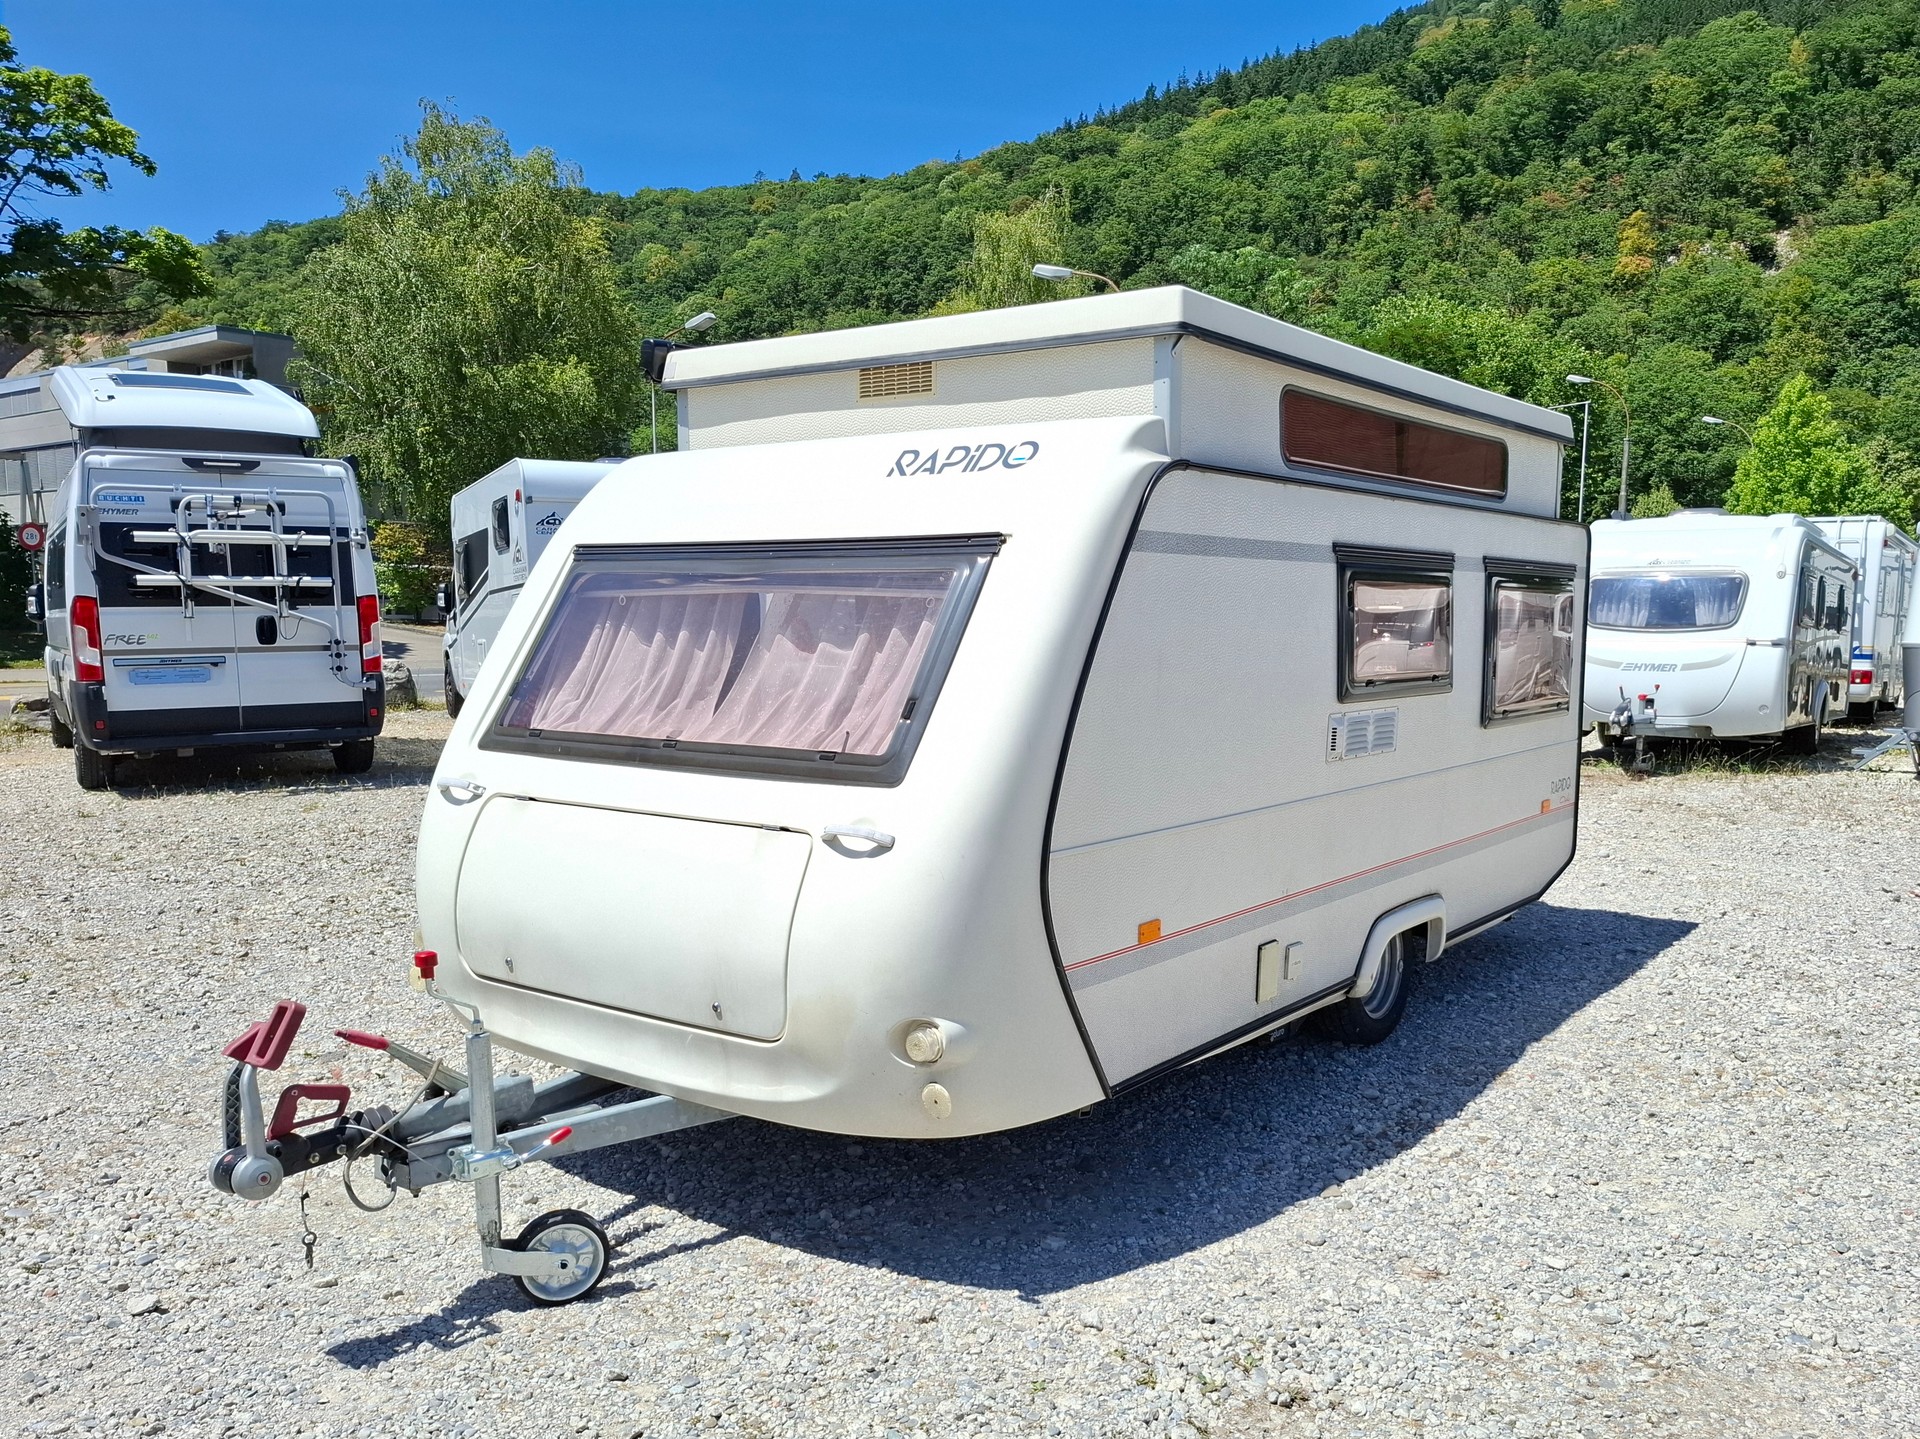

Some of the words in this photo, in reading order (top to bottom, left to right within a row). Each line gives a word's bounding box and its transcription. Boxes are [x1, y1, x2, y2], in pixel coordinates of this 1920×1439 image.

[102, 508, 139, 516] HYMER
[103, 633, 147, 646] FREE
[1632, 662, 1678, 673] HYMER
